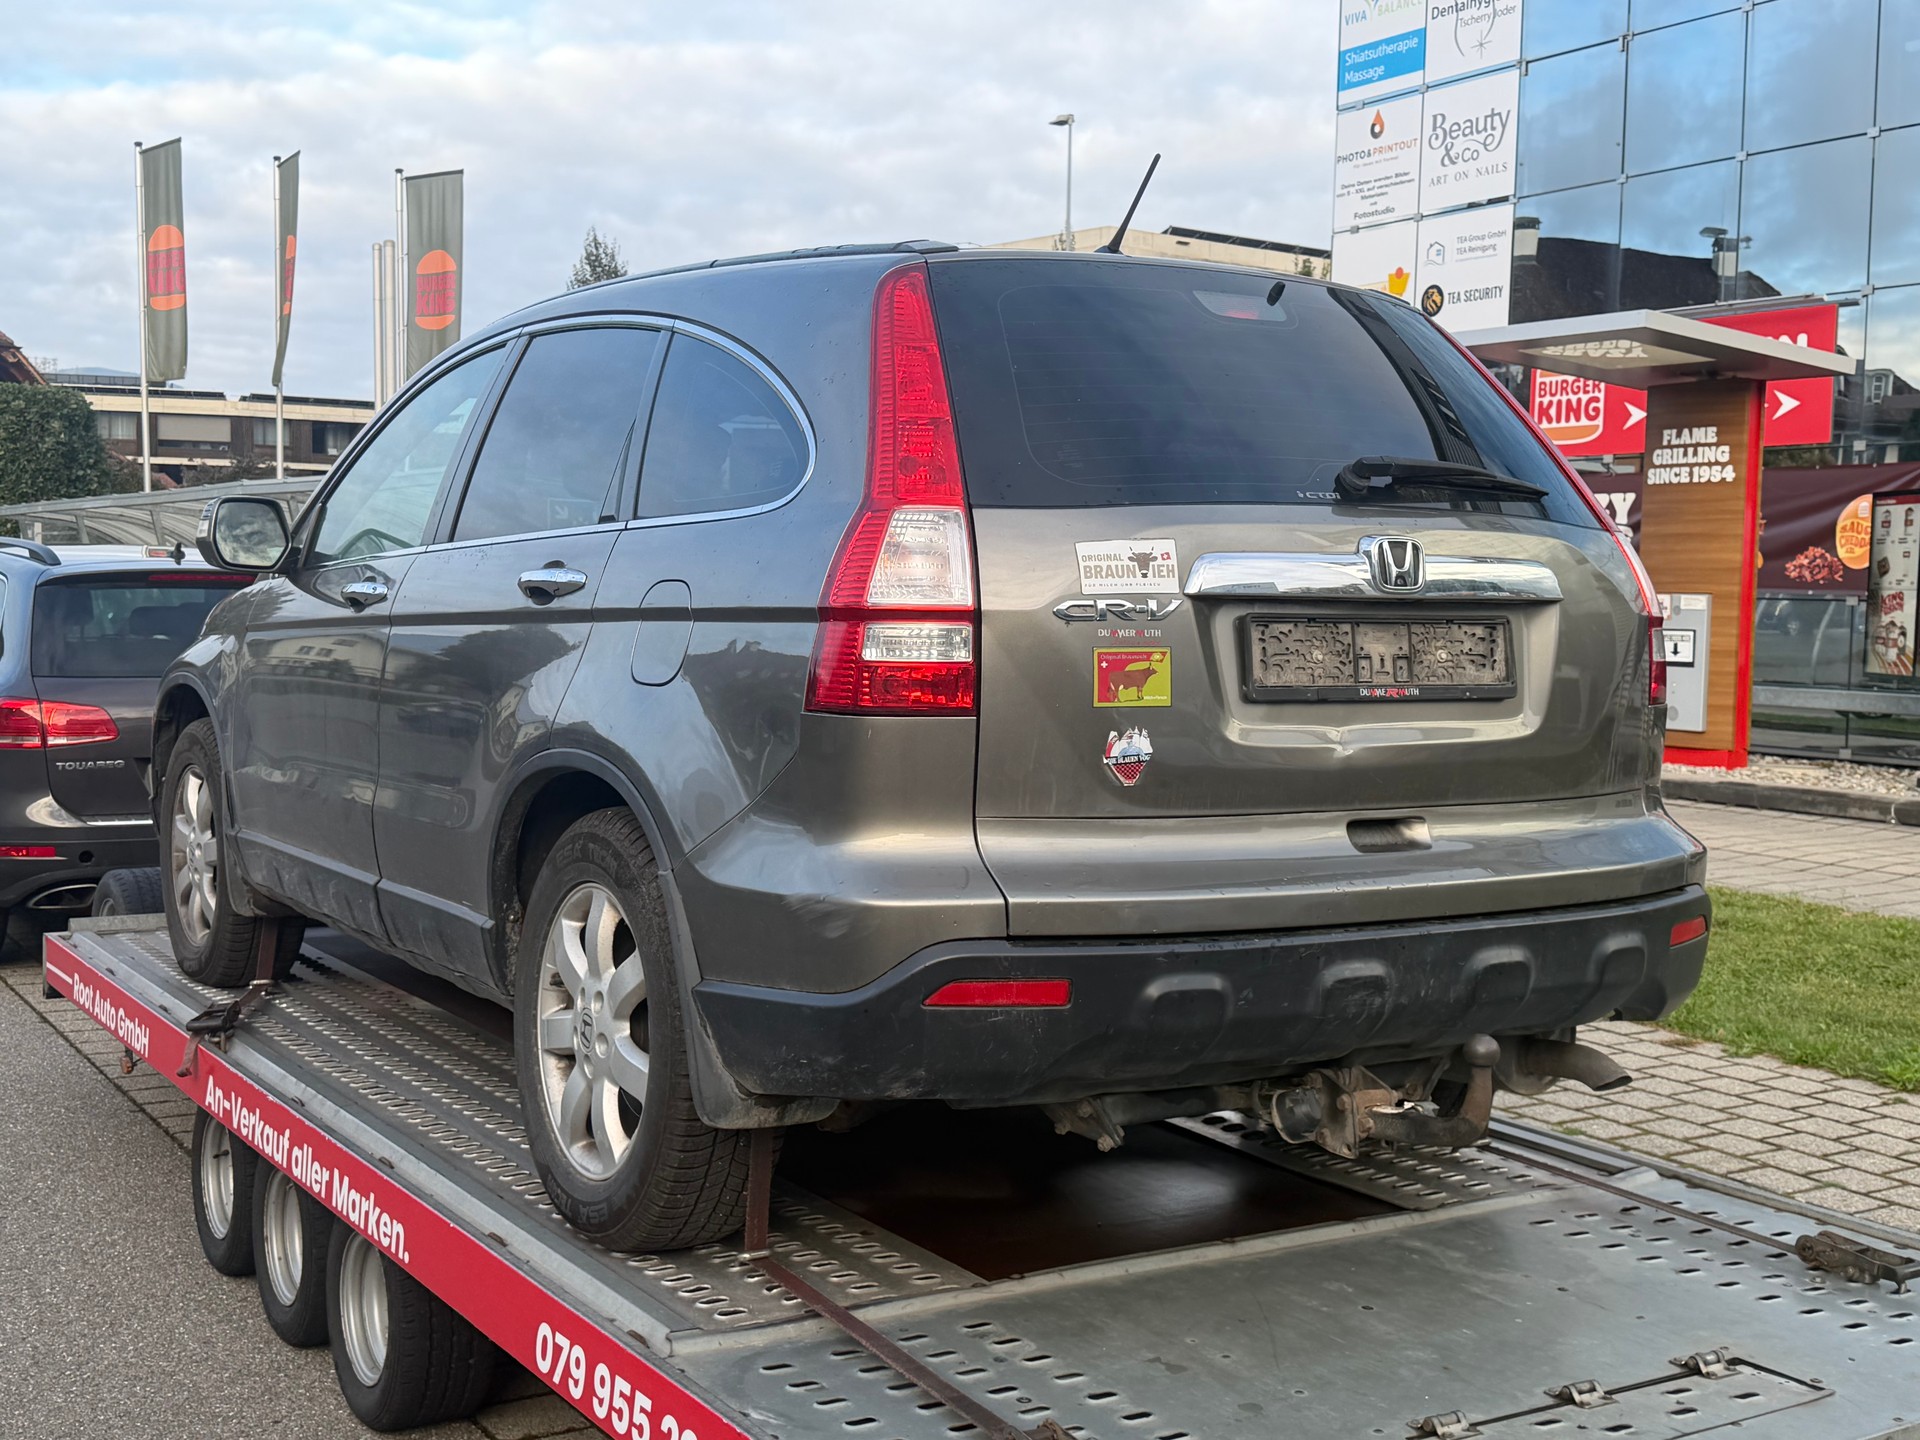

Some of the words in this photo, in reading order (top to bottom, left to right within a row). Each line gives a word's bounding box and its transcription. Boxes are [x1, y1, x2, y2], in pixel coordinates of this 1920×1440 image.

[1344, 10, 1367, 26] VIVA
[1345, 35, 1418, 66] Shiatsutherapie
[1344, 65, 1385, 84] Massage
[1428, 107, 1511, 152] Beauty
[1428, 174, 1449, 187] ART
[1454, 170, 1469, 182] ON
[1475, 161, 1508, 178] NAILS
[1354, 206, 1396, 220] Fotostudio
[1456, 236, 1468, 244] TEA
[1468, 233, 1487, 243] Group
[1456, 247, 1468, 255] TEA
[1448, 291, 1462, 305] TEA
[1463, 285, 1504, 303] SECURITY
[1538, 377, 1602, 398] BURGER
[1537, 396, 1601, 425] KING
[1662, 426, 1718, 446] FLAME
[1653, 445, 1730, 465] GRILLING
[1647, 466, 1691, 485] SINCE
[1692, 464, 1736, 483] 1954
[1081, 553, 1124, 562] ORIGINAL
[1052, 599, 1184, 621] CR-V
[56, 760, 125, 770] TOUAREG
[73, 972, 94, 1009] Root
[94, 990, 116, 1031] Auto
[117, 1007, 149, 1058] GmbH
[205, 1075, 290, 1169] An-Verkauf
[291, 1143, 331, 1199] aller
[331, 1168, 410, 1264] Marken.
[536, 1322, 586, 1400] 079
[592, 1362, 652, 1440] 955
